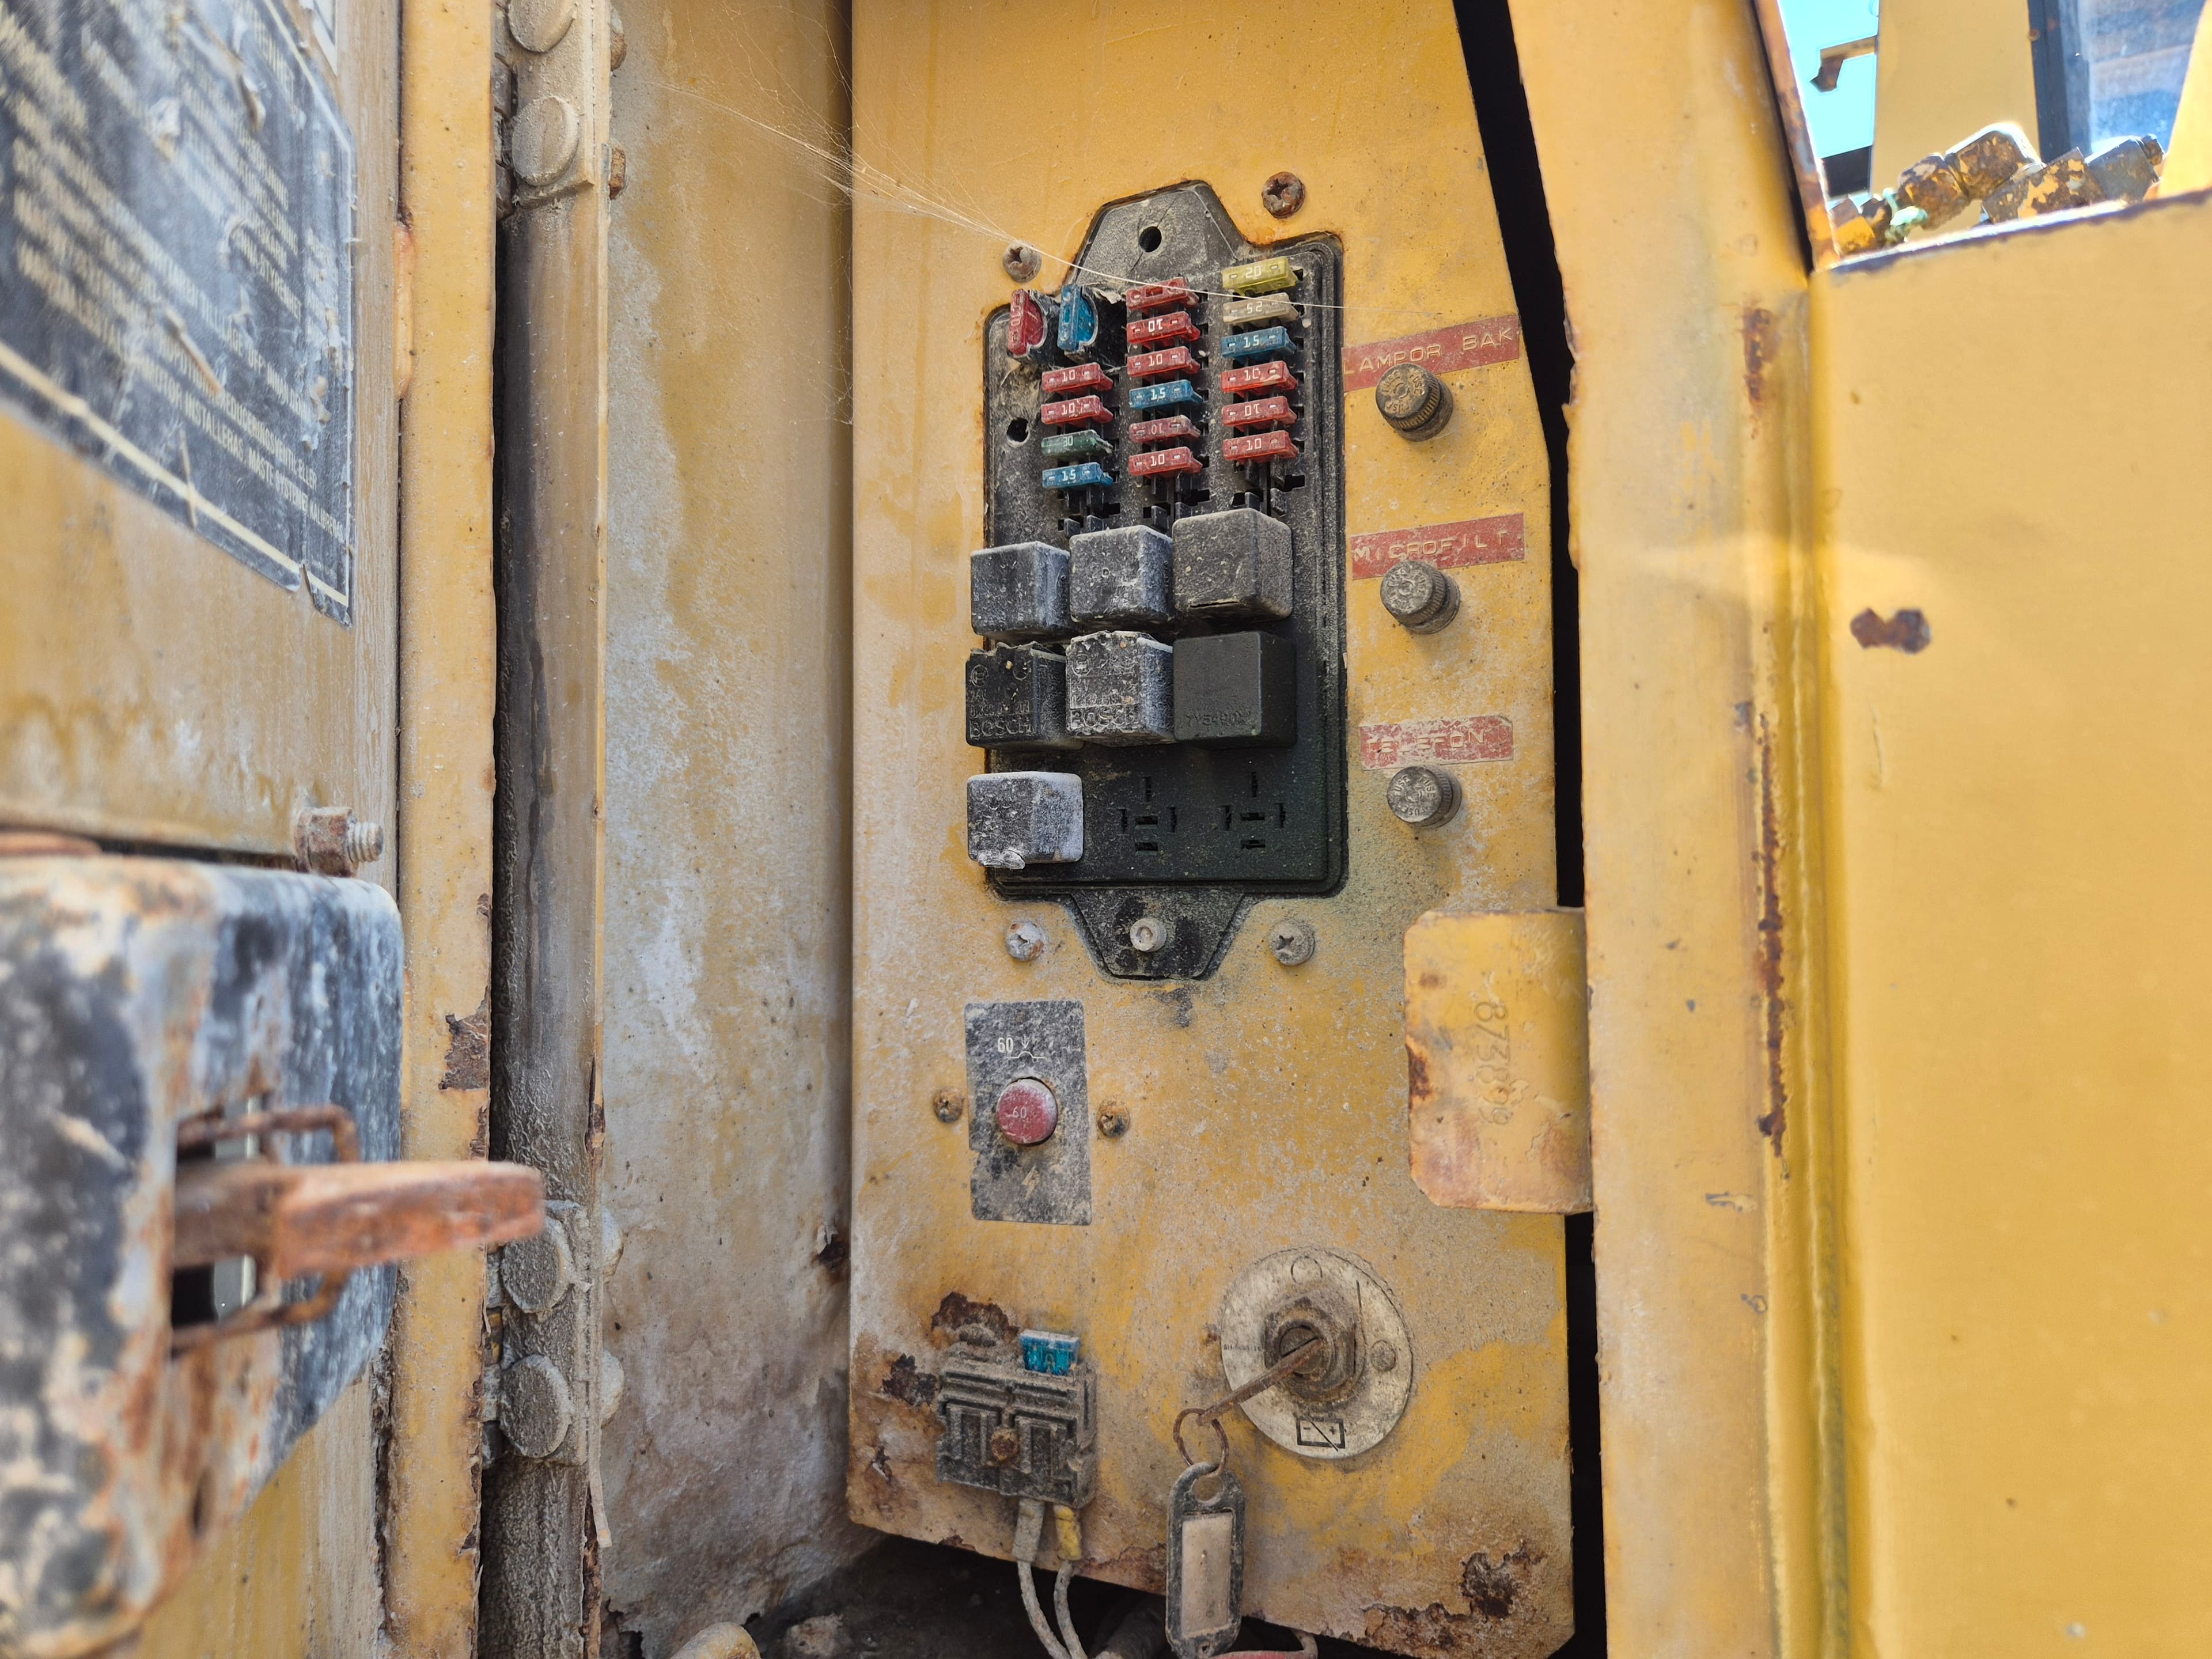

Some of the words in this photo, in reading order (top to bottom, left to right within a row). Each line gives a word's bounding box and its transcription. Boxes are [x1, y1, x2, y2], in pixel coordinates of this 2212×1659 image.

[1246, 266, 1262, 279] 20
[1148, 319, 1163, 332] 10
[1244, 335, 1259, 348] 15
[1343, 344, 1442, 375] LAMPOR
[1462, 327, 1513, 351] BAK
[1148, 353, 1163, 367] 10
[1062, 369, 1075, 382] 10
[1244, 367, 1261, 381] 10
[1150, 387, 1166, 400] 15
[1062, 403, 1075, 415] 10
[1245, 404, 1260, 416] 10
[1247, 438, 1262, 451] 10
[1150, 454, 1165, 467] 10
[1062, 469, 1076, 482] 15
[1367, 729, 1485, 754] TELEFON
[998, 1037, 1014, 1052] 60
[1013, 1108, 1027, 1119] 60
